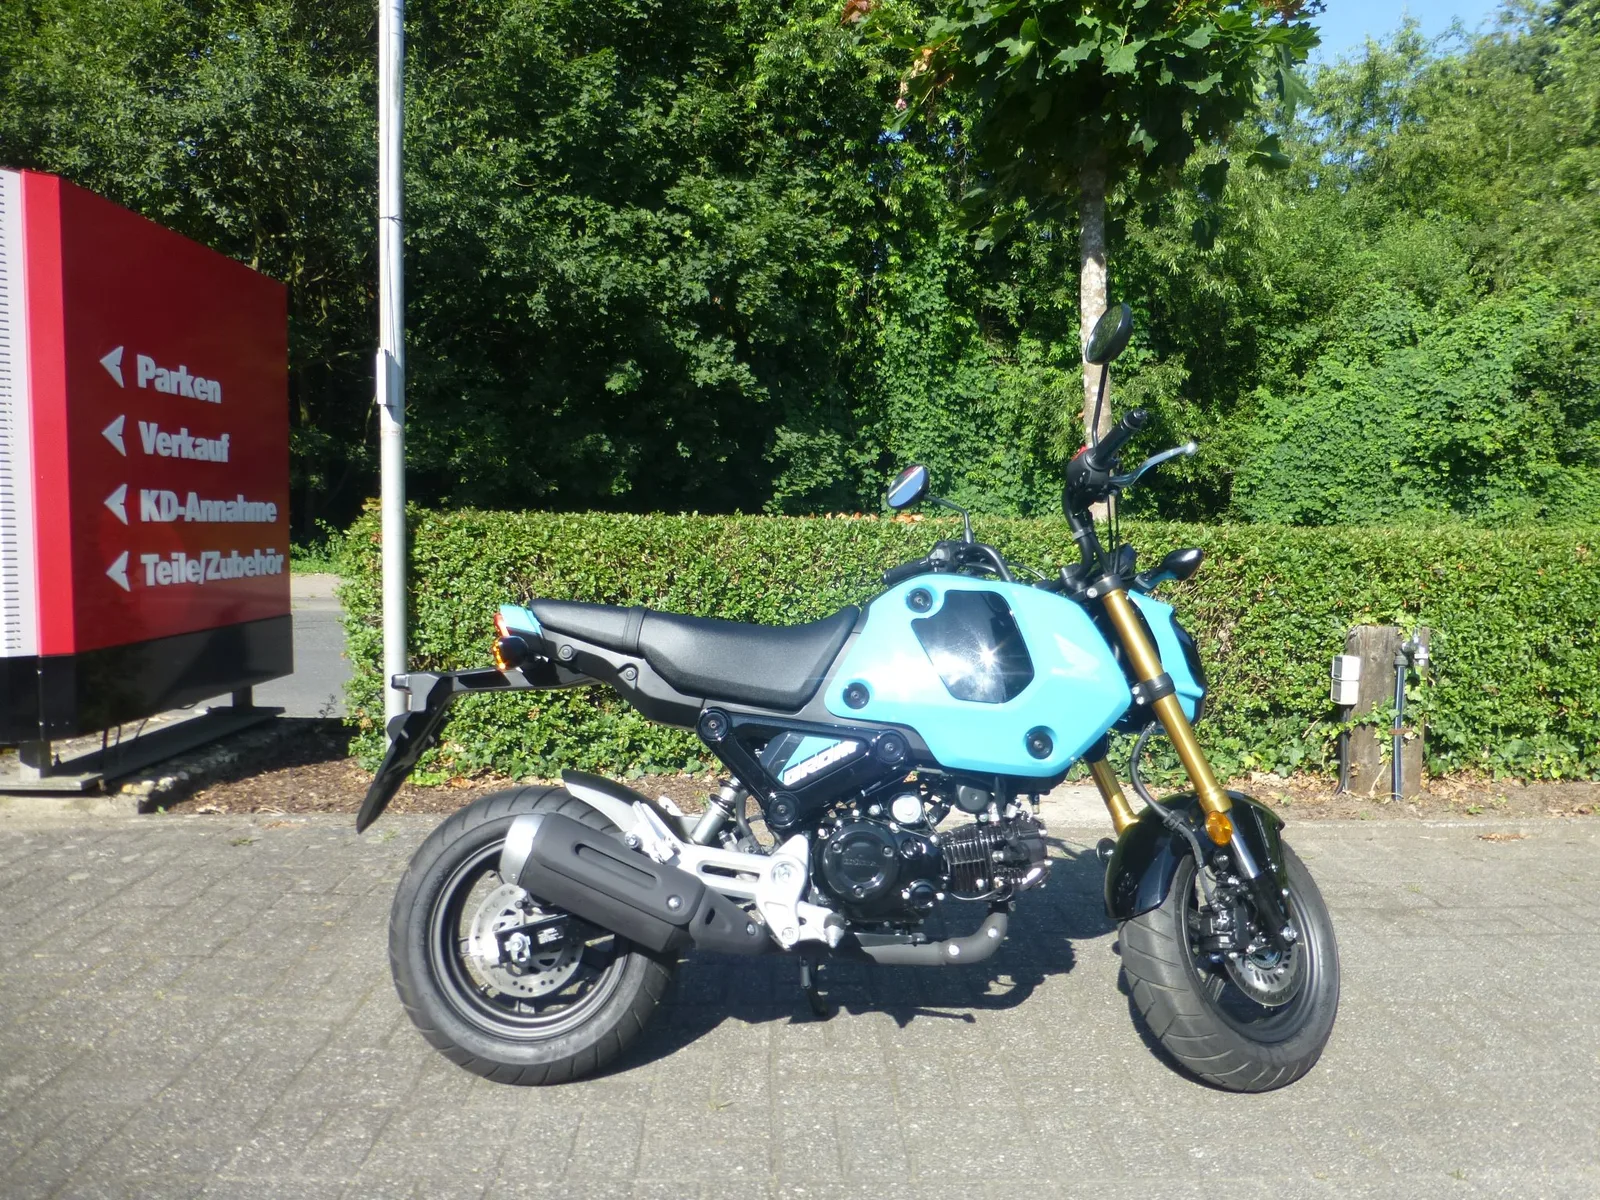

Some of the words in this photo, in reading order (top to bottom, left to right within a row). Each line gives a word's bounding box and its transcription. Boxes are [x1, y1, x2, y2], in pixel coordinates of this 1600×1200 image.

[136, 354, 222, 404] Parken
[138, 420, 230, 463] Verkauf
[140, 488, 278, 523] KD-Annahme
[140, 548, 284, 586] Teile/Zubehör
